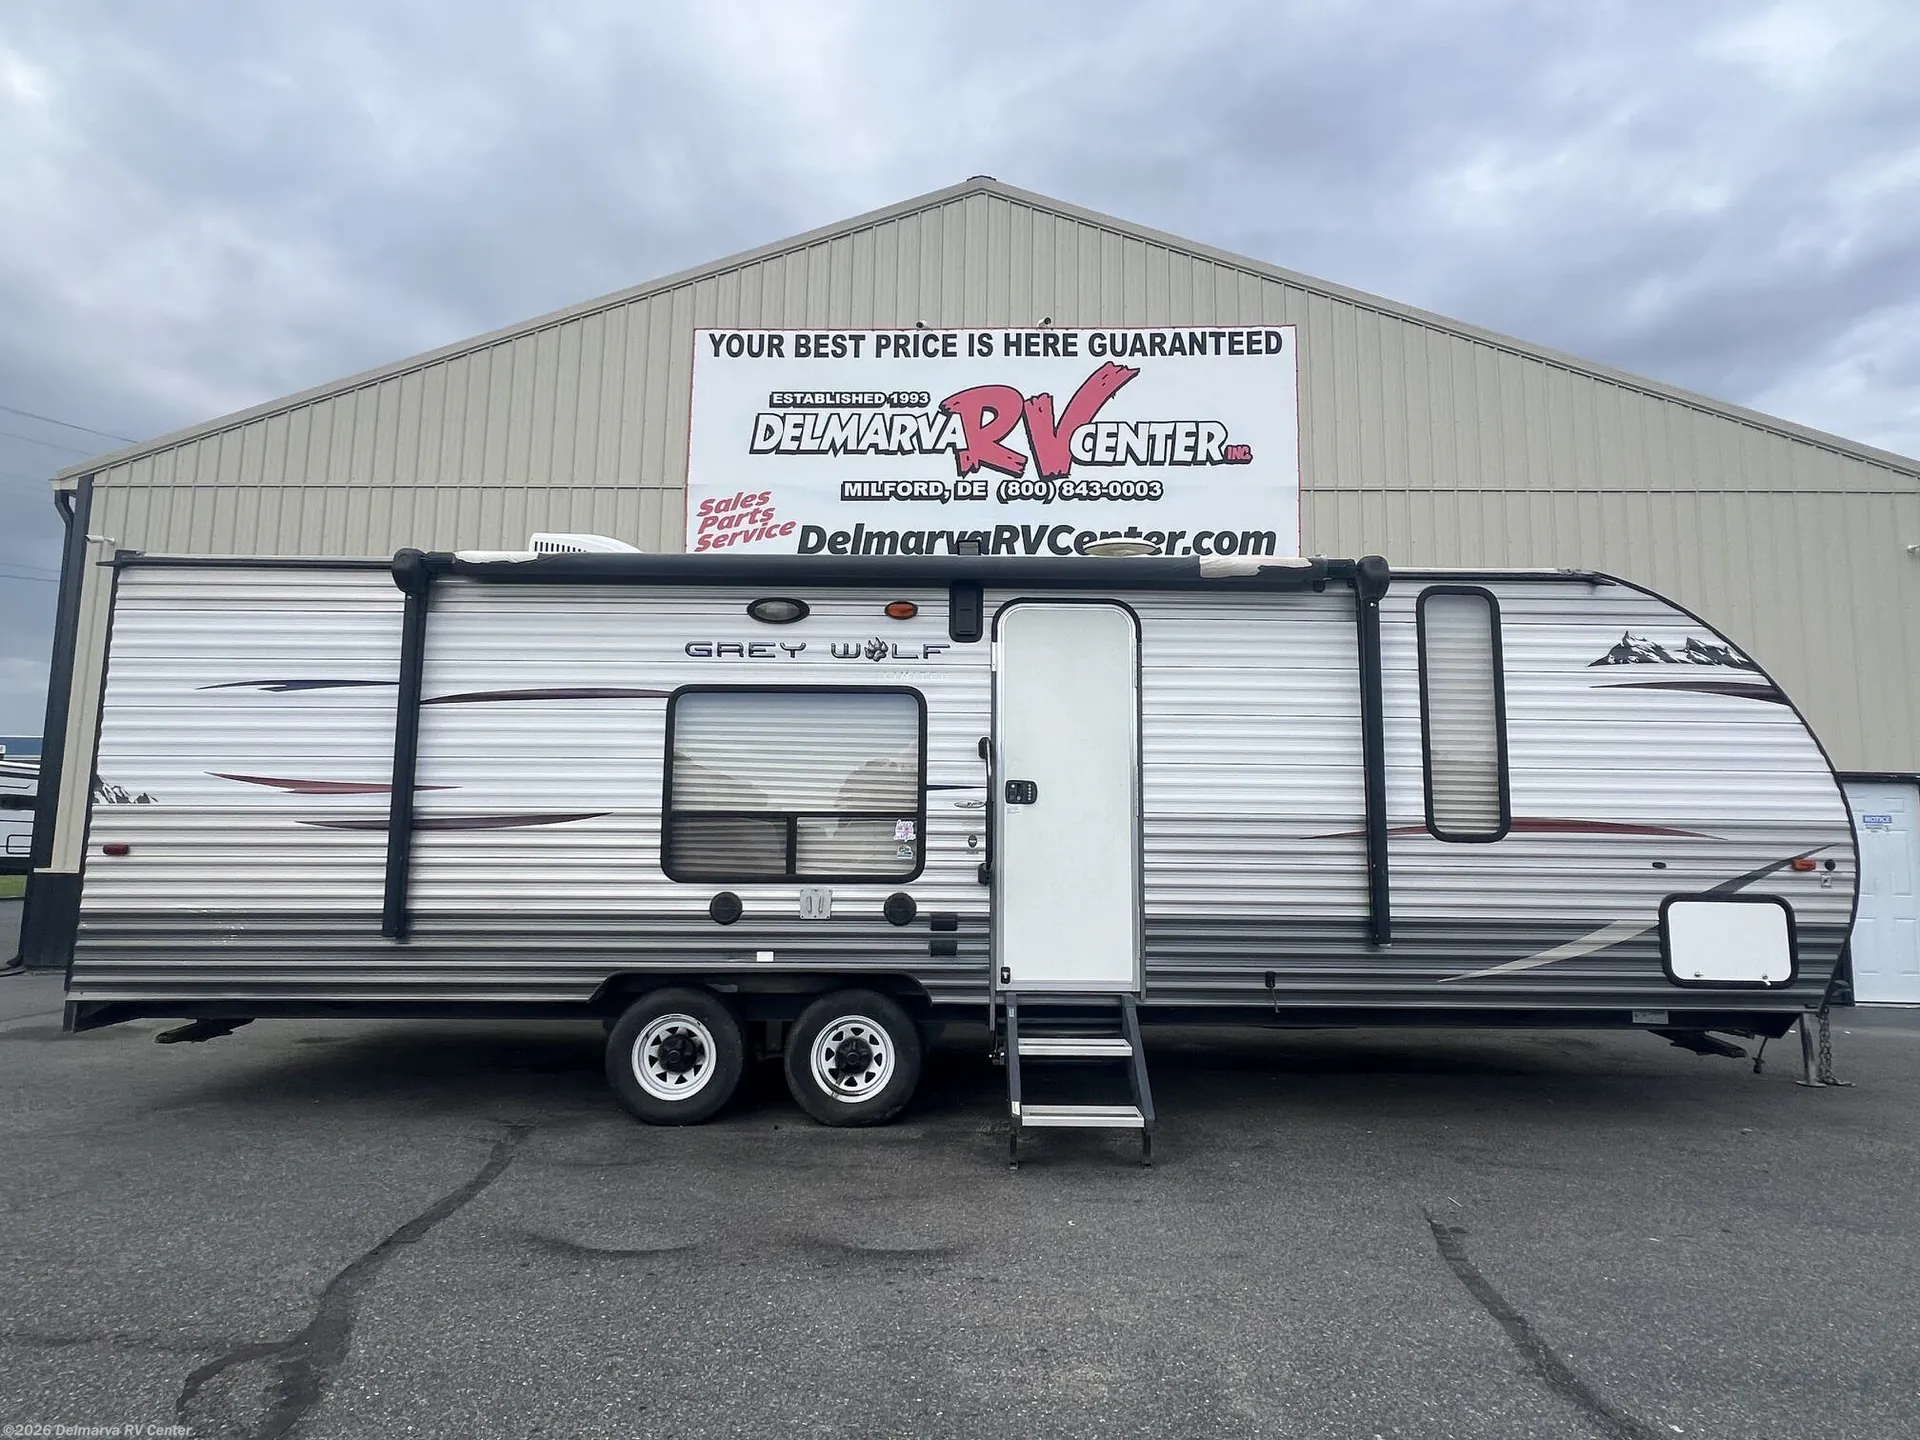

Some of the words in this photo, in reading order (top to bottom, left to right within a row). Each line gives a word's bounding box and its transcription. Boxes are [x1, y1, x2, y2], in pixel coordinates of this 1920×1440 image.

[709, 333, 785, 358] YOUR
[794, 333, 866, 358] BEST
[875, 333, 958, 358] PRICE
[969, 333, 994, 357] IS
[1004, 333, 1078, 357] HERE
[1088, 330, 1283, 356] GUARANTEED
[770, 392, 886, 407] ESTABLISHED
[889, 391, 931, 407] 1993
[749, 412, 968, 457] DELMARVA
[939, 361, 1141, 480] RV
[1070, 420, 1229, 466] CENTER
[697, 490, 772, 517] Sales
[841, 480, 951, 502] MILFORD,
[954, 480, 988, 499] DE
[997, 480, 1056, 503] (800)
[1060, 480, 1164, 500] 843-0003
[697, 506, 776, 535] Parts
[696, 520, 797, 552] Service
[684, 640, 807, 659] GREY
